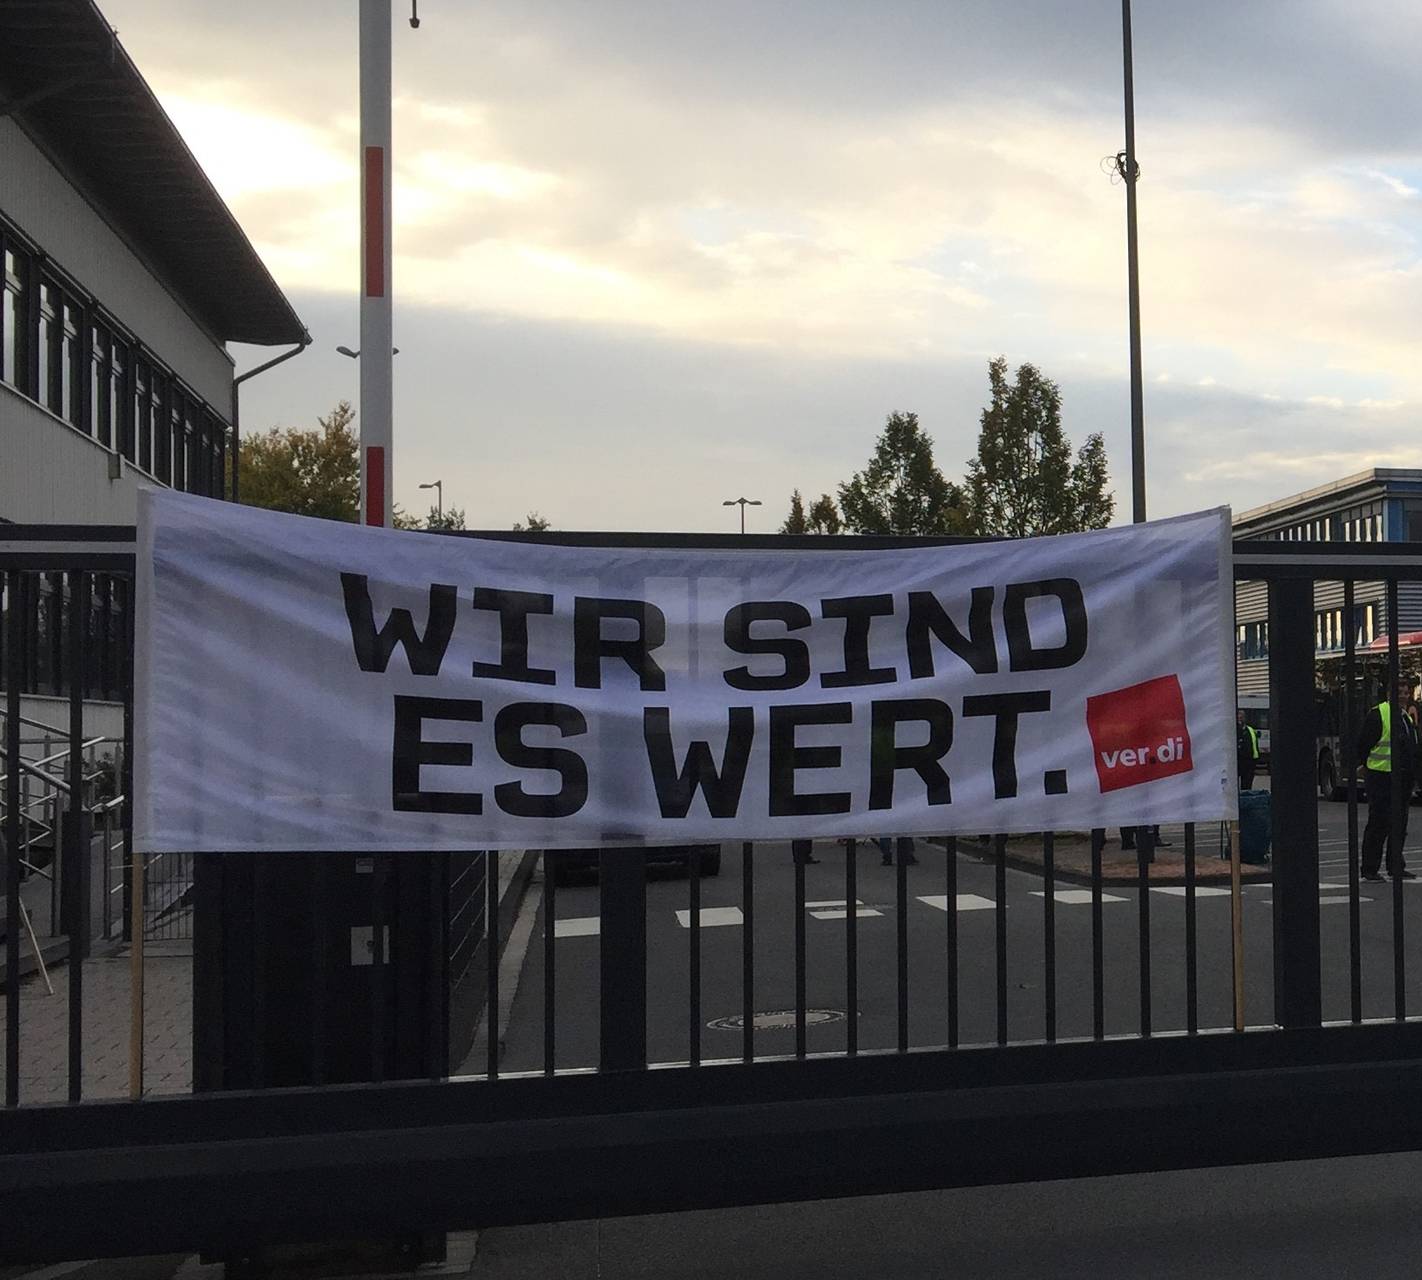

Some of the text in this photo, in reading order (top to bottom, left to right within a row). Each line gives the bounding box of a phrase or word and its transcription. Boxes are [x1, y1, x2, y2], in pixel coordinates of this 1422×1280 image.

[340, 572, 1088, 691] WIR SIND
[393, 690, 1068, 818] ES WERT.
[1101, 737, 1184, 769] ver.di
